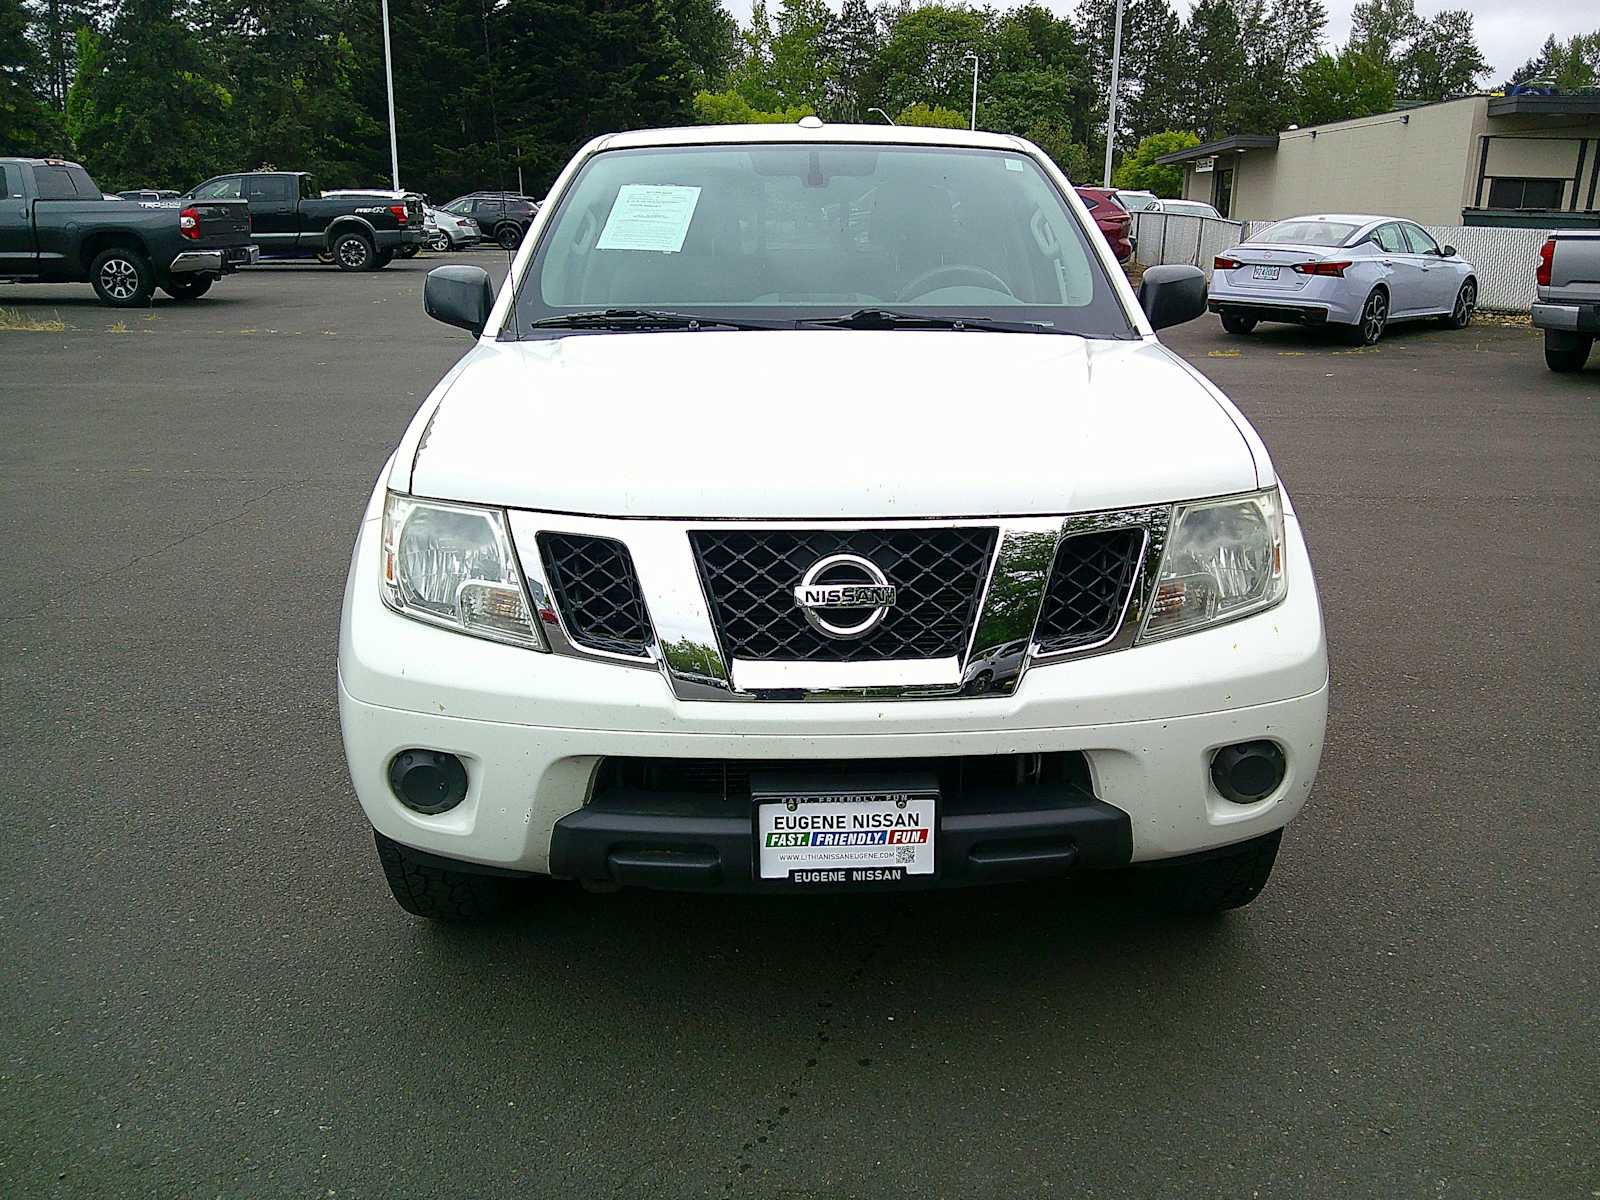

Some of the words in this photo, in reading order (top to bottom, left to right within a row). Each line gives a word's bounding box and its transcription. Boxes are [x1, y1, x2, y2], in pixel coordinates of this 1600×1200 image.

[805, 589, 886, 603] NISSAN
[774, 815, 846, 830] EUGENE
[853, 813, 919, 829] NISSAN
[770, 833, 806, 846] FAST.
[816, 832, 884, 845] FRIENDLY.
[892, 830, 924, 844] FUN.
[794, 871, 846, 883] EUGENE
[852, 869, 901, 881] NISSAN
